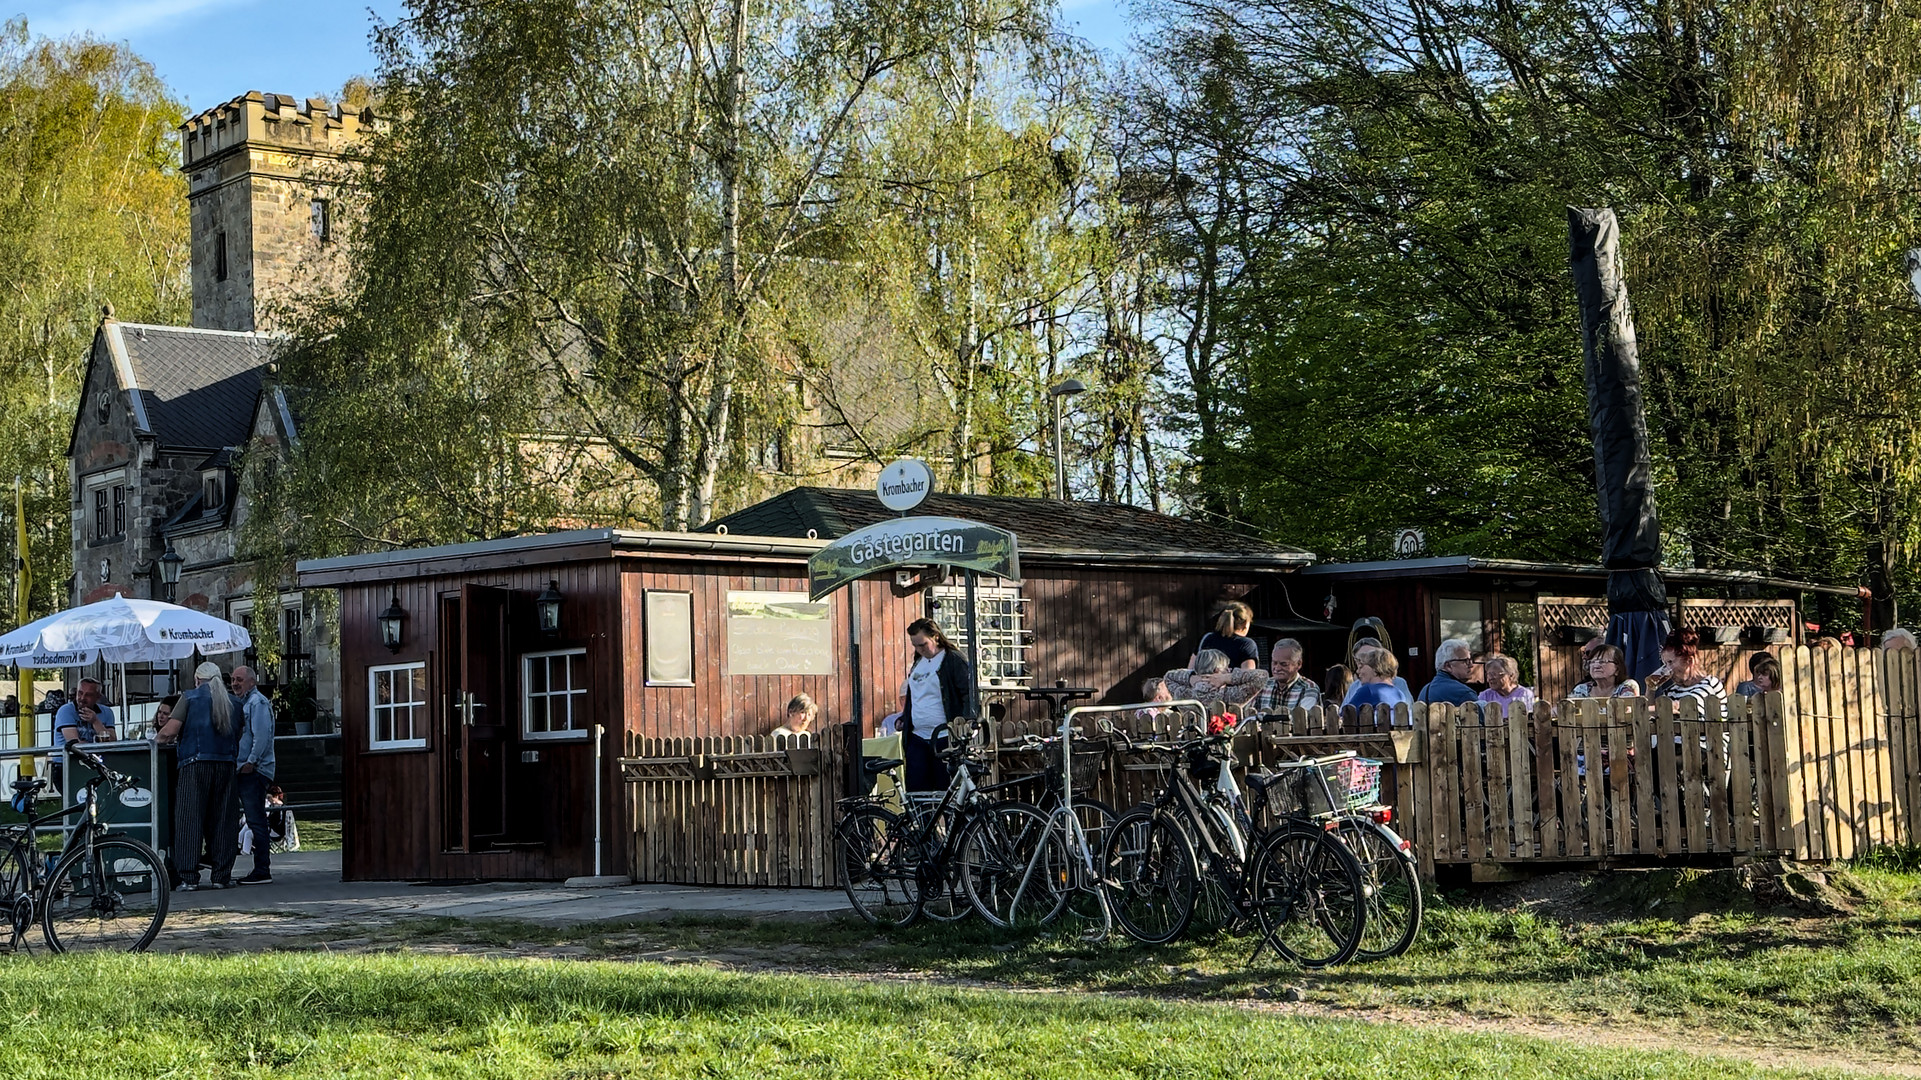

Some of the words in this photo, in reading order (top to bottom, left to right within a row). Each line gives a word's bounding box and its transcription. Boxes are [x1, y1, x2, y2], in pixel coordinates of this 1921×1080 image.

[882, 478, 925, 497] Krombacher
[850, 528, 964, 565] Gästegarten
[1403, 540, 1416, 554] 30
[168, 628, 215, 640] Krombacher
